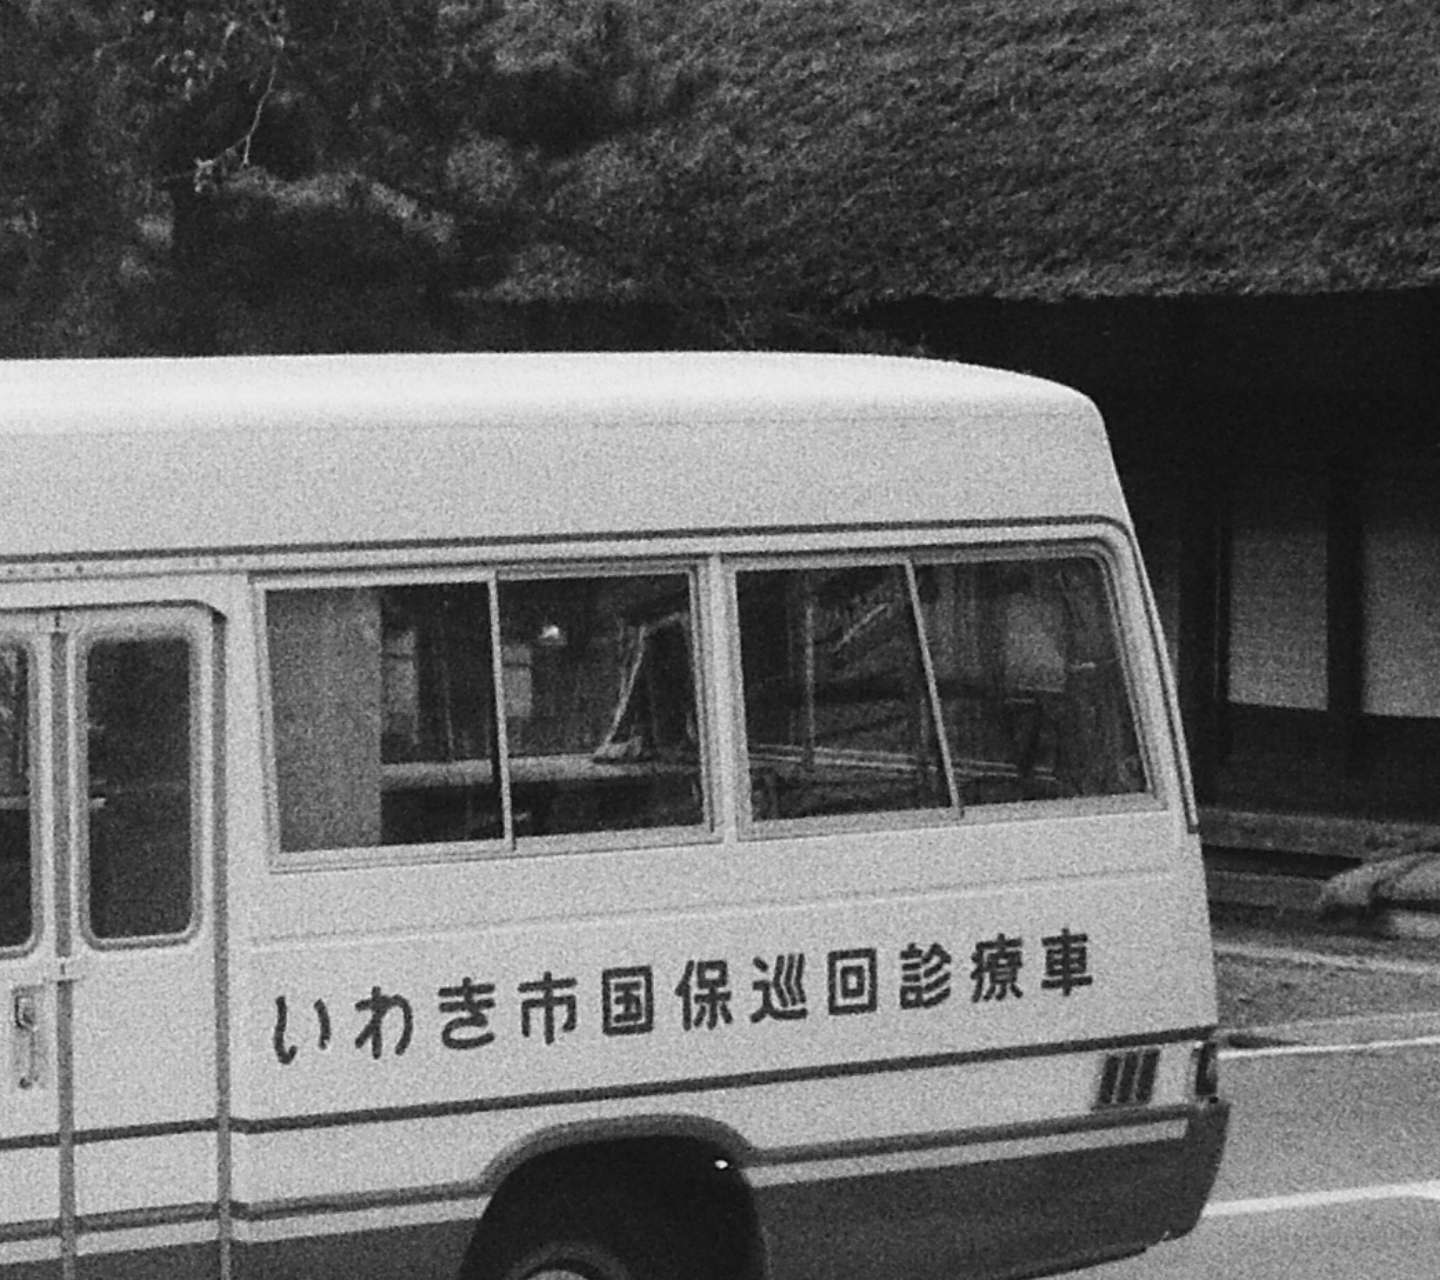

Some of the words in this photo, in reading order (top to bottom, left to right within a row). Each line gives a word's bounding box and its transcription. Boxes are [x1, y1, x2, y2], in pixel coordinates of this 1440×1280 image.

[271, 928, 1094, 1066] いわき市国保巡回診療車
